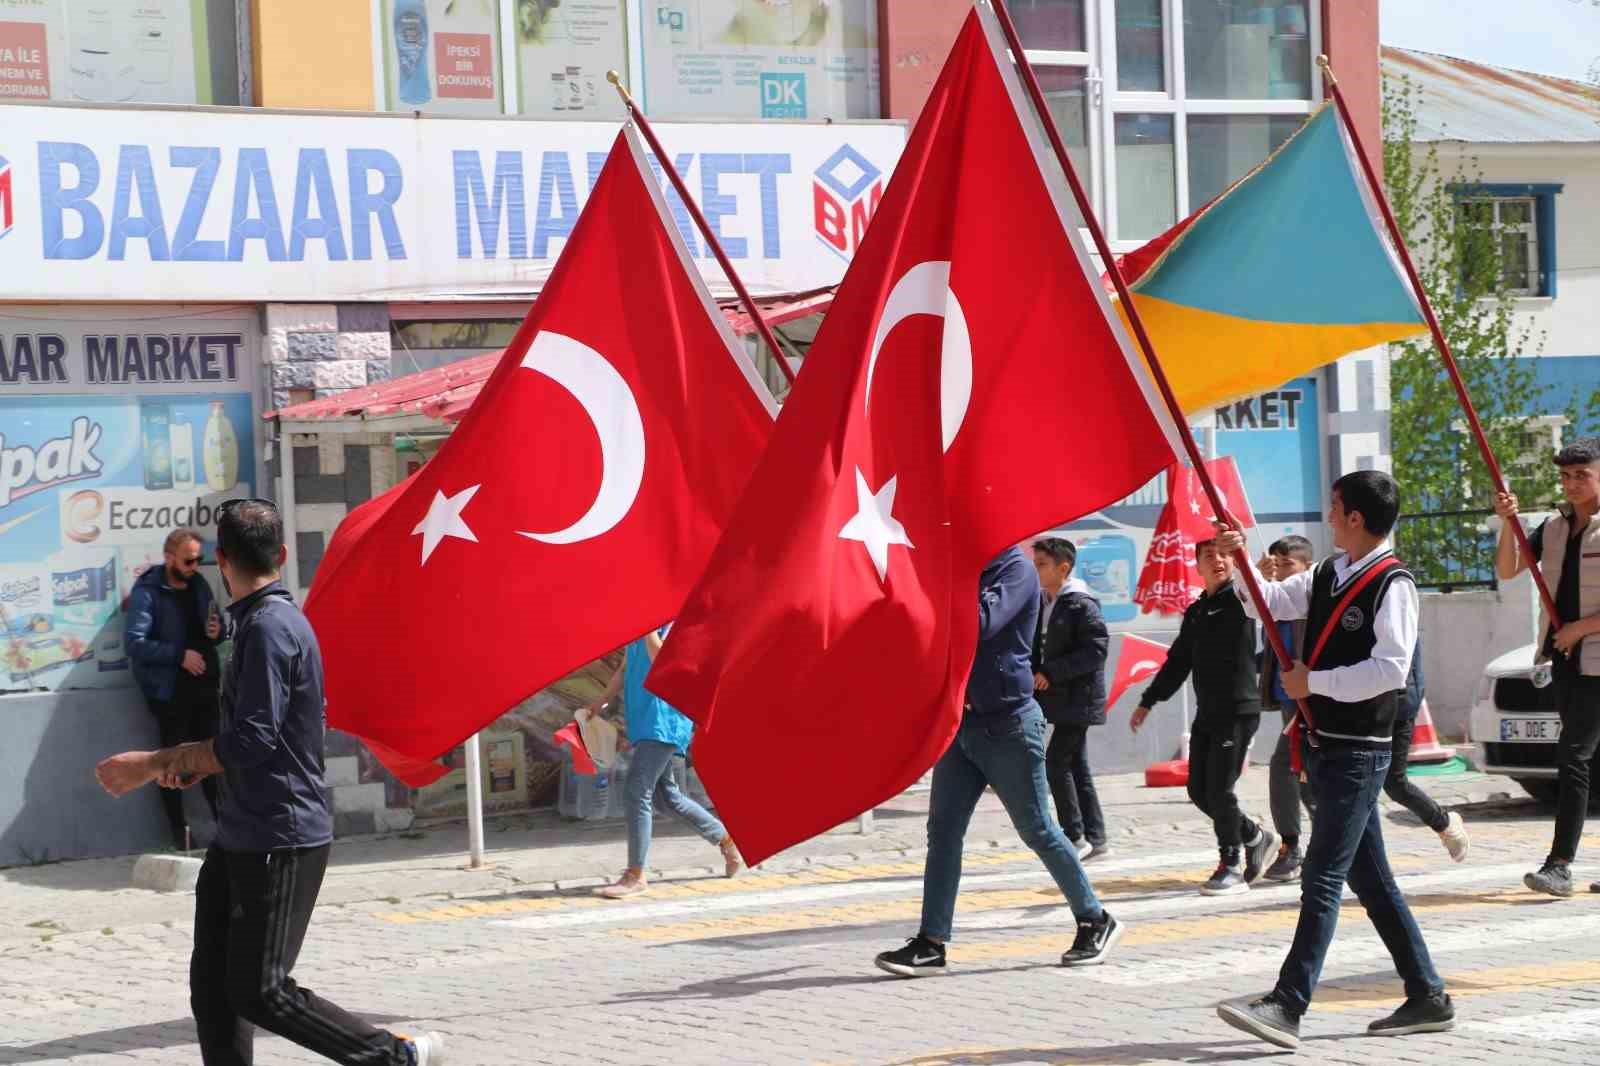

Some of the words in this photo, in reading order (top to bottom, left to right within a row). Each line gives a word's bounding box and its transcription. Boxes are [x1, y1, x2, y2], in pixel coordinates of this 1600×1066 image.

[18, 45, 41, 64] İLE
[764, 79, 802, 105] DK
[37, 141, 407, 261] BAZAAR
[451, 149, 792, 260] MAKET
[84, 333, 243, 384] MARKET
